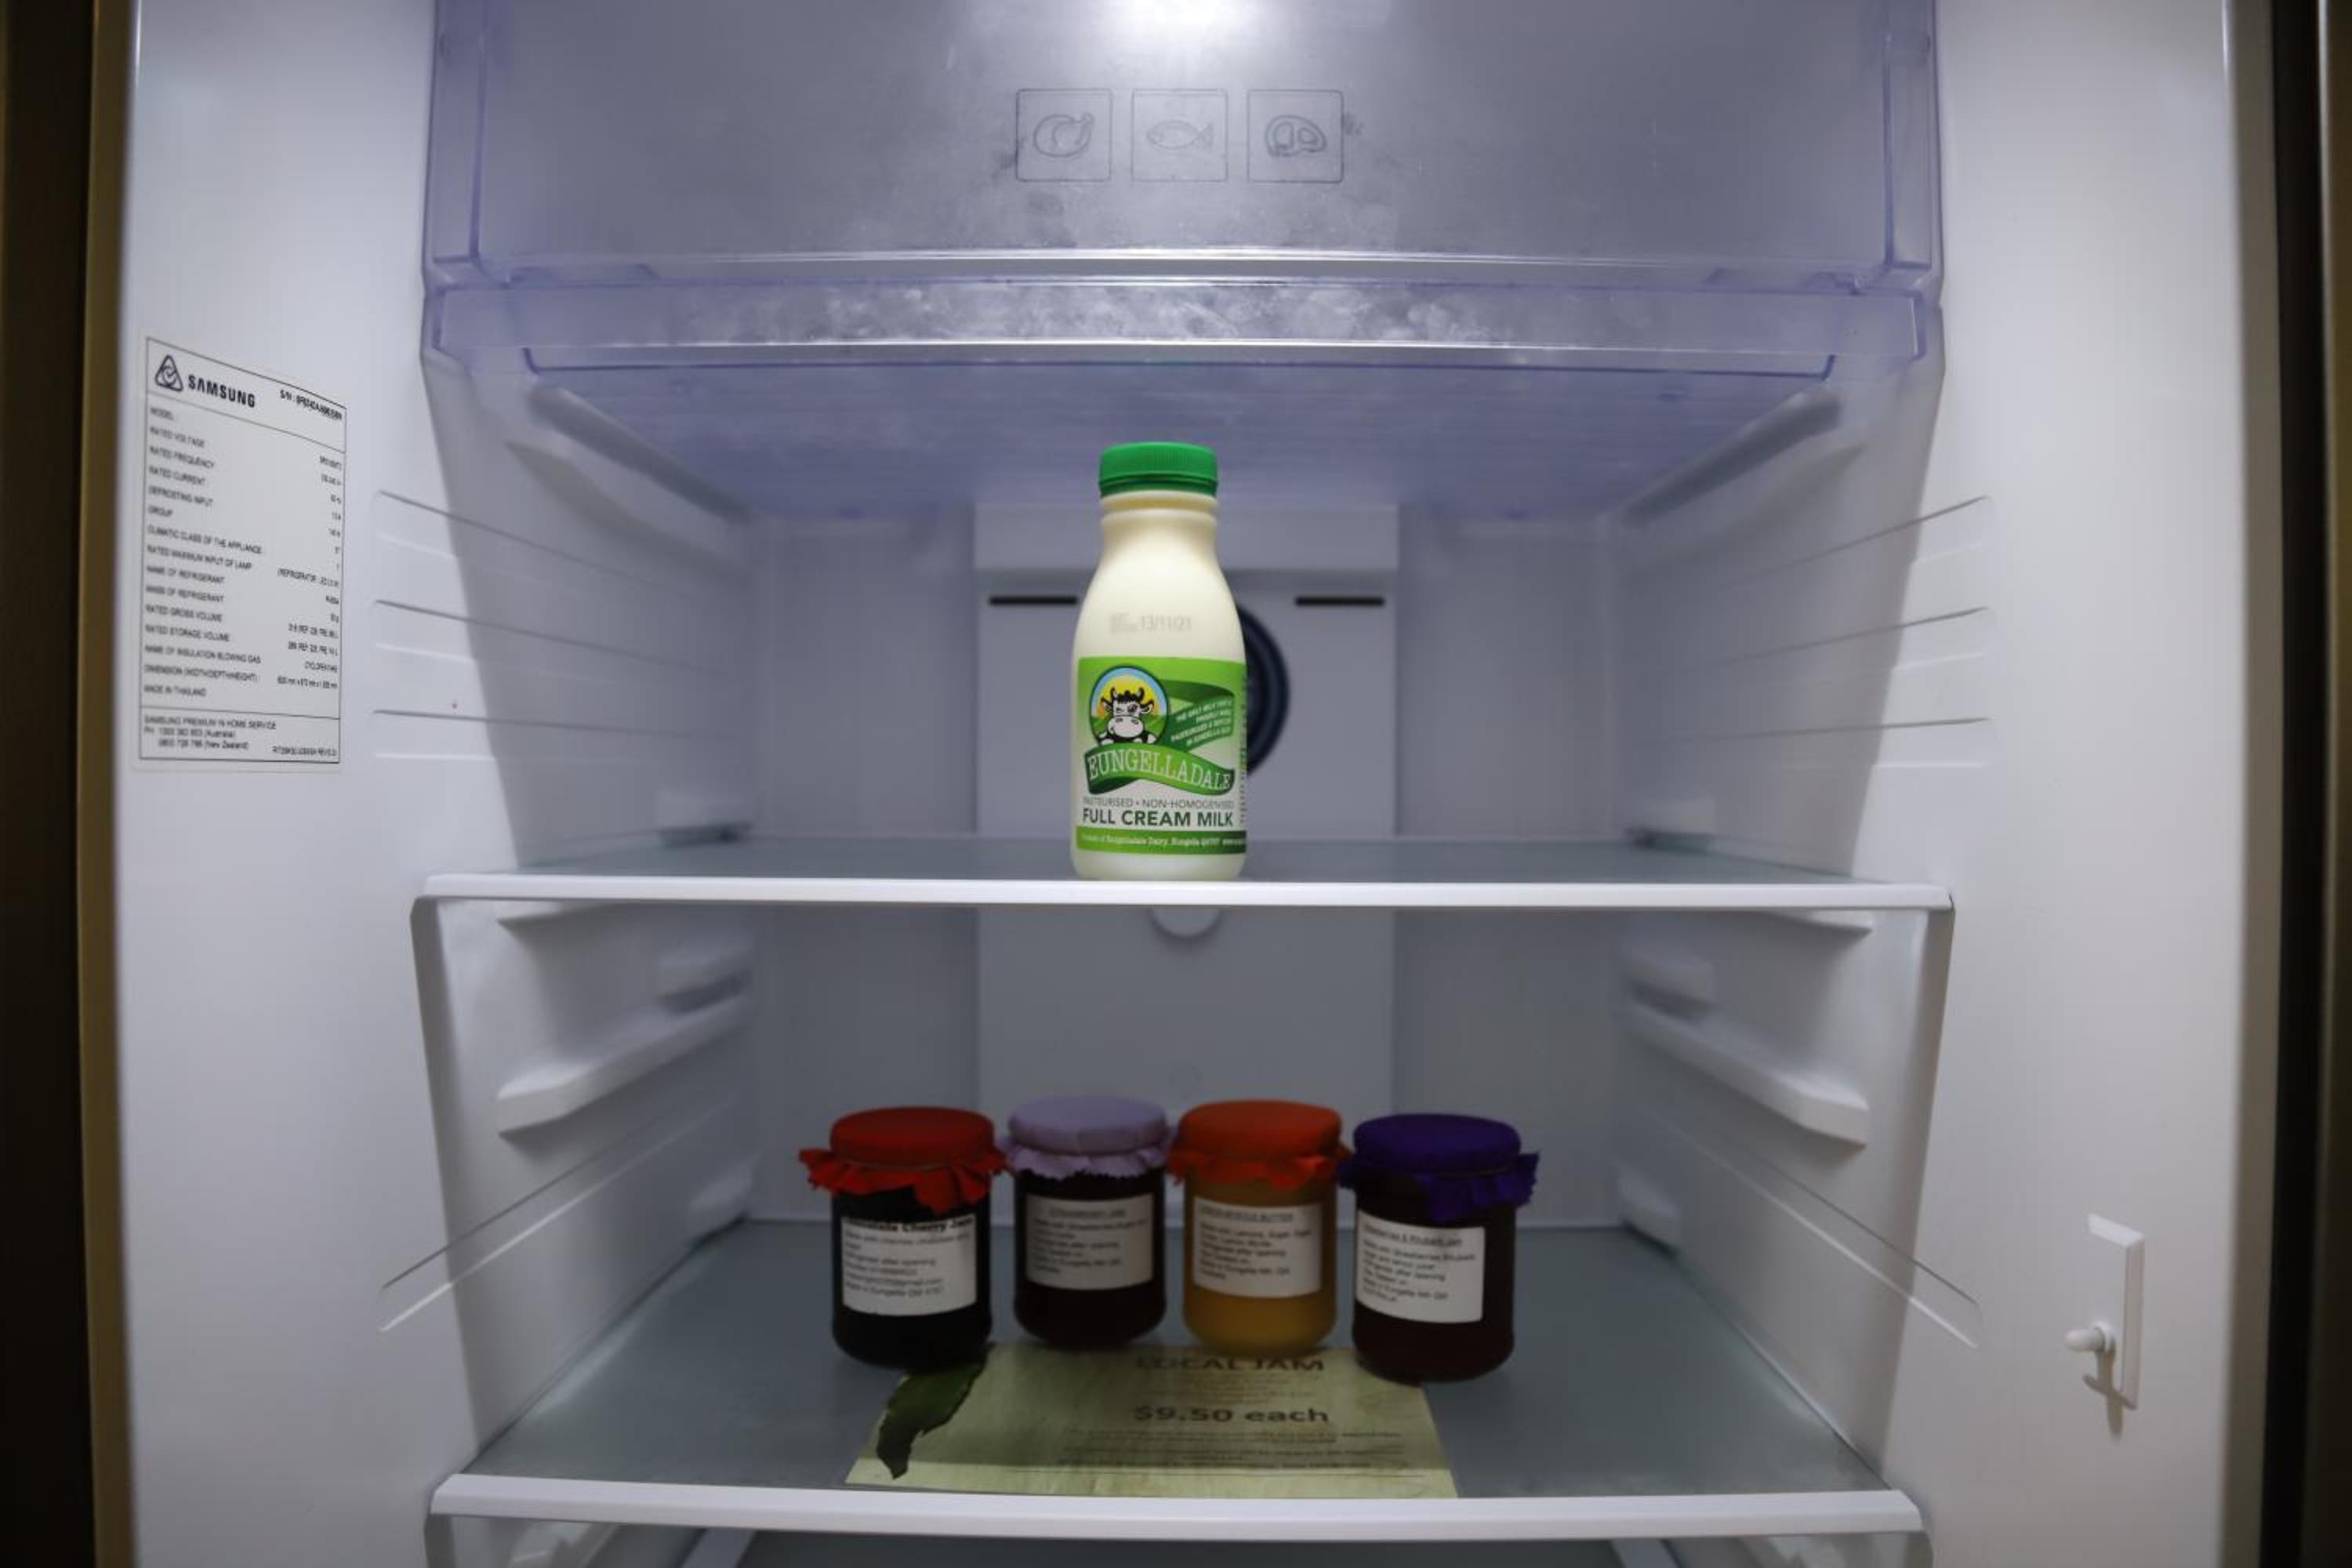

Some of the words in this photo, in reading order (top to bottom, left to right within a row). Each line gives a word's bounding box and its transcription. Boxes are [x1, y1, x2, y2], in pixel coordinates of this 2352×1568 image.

[188, 375, 256, 408] SAMSUNG
[150, 426, 172, 439] RATED
[150, 445, 172, 459] RATED
[174, 452, 215, 469] FREQUENCY
[149, 466, 172, 478] RATED
[173, 470, 205, 485] CURRENT
[147, 524, 179, 539] CLIMATIC
[214, 537, 226, 548] THE
[228, 540, 263, 554] APPLIANCE
[147, 545, 169, 557] RATED
[205, 555, 223, 565] INPUT
[235, 560, 252, 570] LAMP
[179, 569, 225, 584] REFRIGERANT
[178, 589, 225, 603] REFRIGERANT
[146, 604, 169, 615] RATED
[196, 611, 223, 622] VOLUME
[145, 623, 168, 635] RATED
[170, 626, 201, 639] STORAGE
[204, 631, 230, 642] VOLUME
[177, 648, 216, 659] INSULATION
[248, 655, 261, 664] GAS
[227, 719, 246, 728] HOME
[249, 720, 276, 729] SERVICE
[1087, 749, 1232, 790] EUNGELLADALE
[1083, 808, 1116, 824] FULL
[1121, 810, 1191, 826] CREAM
[1197, 811, 1234, 827] MILK
[1136, 1356, 1244, 1370] LOCAL
[1254, 1357, 1325, 1371] JAM
[1134, 1405, 1235, 1422] $9.50
[1243, 1407, 1330, 1423] each
